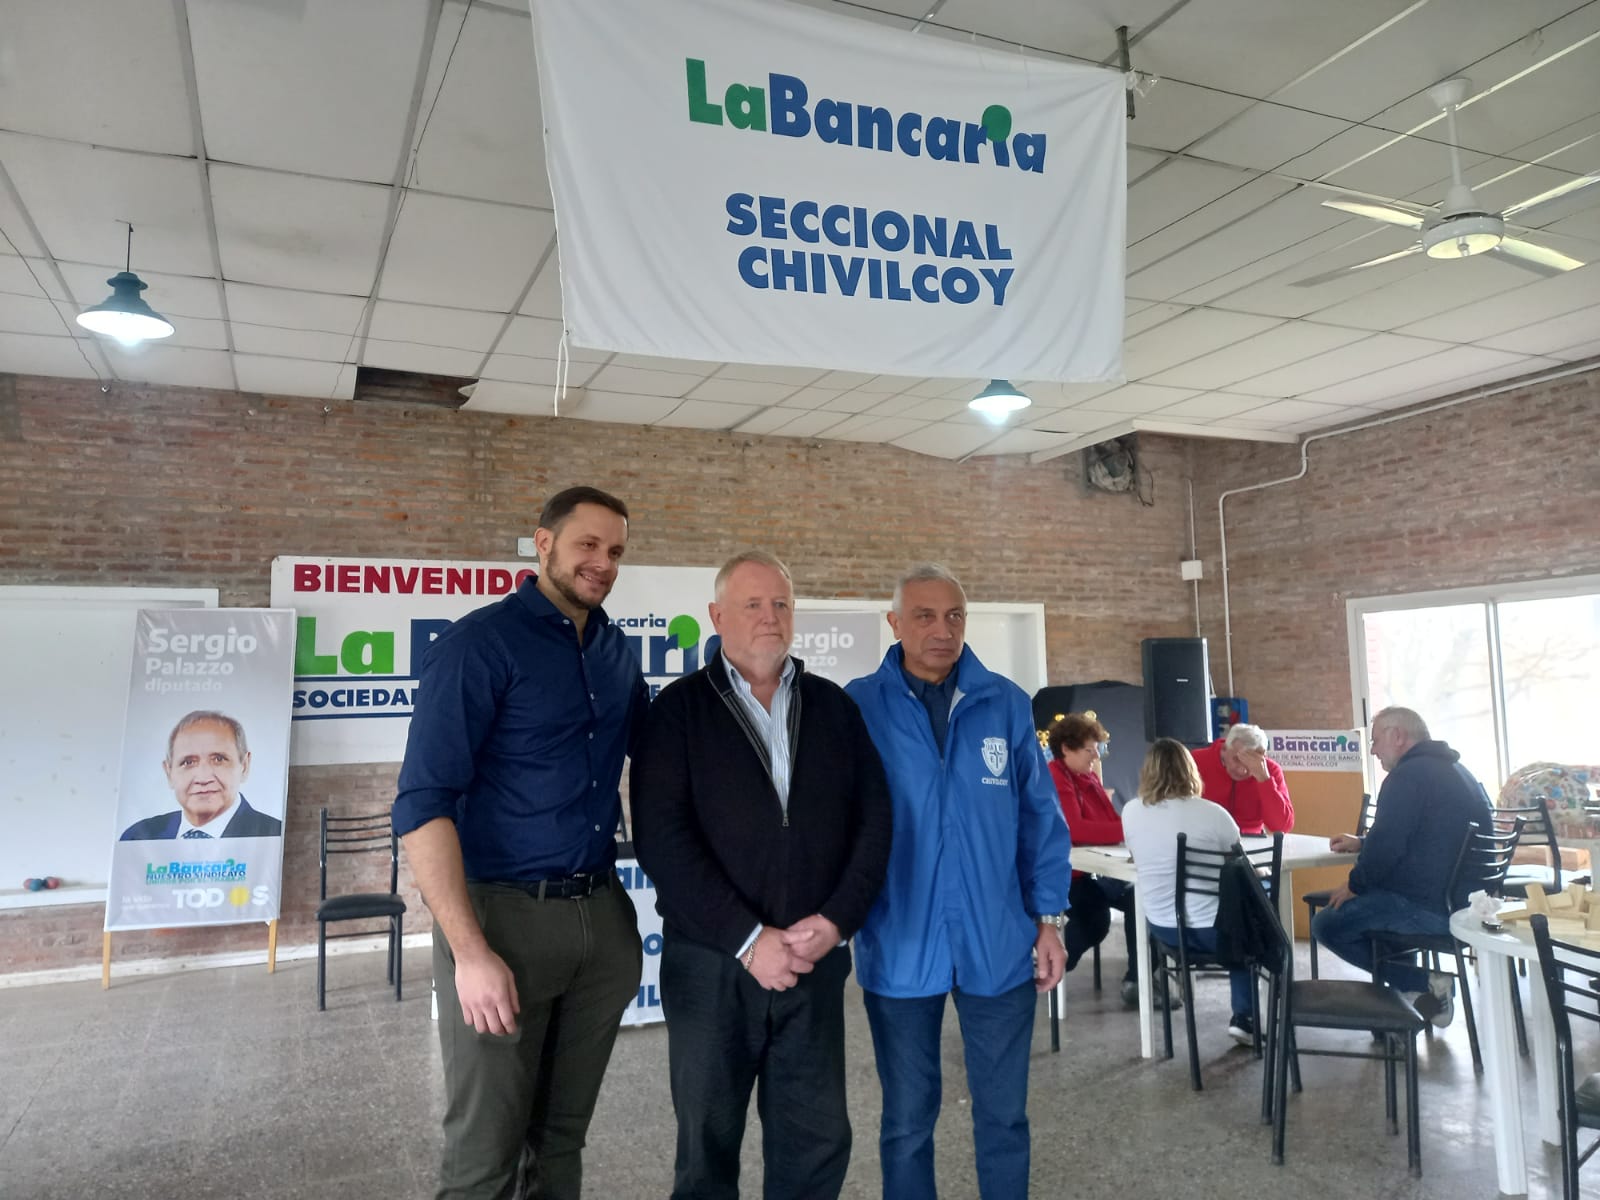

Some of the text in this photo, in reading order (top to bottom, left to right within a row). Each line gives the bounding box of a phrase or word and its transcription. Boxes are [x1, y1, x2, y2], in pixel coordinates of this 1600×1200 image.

[686, 57, 1047, 174] LaBancaria
[726, 193, 1013, 261] SECCIONAL
[738, 246, 1015, 306] CHIVILCOY
[148, 627, 257, 660] Sergio
[792, 626, 855, 654] ergio
[145, 656, 234, 676] Palazzo
[144, 678, 222, 695] diputado
